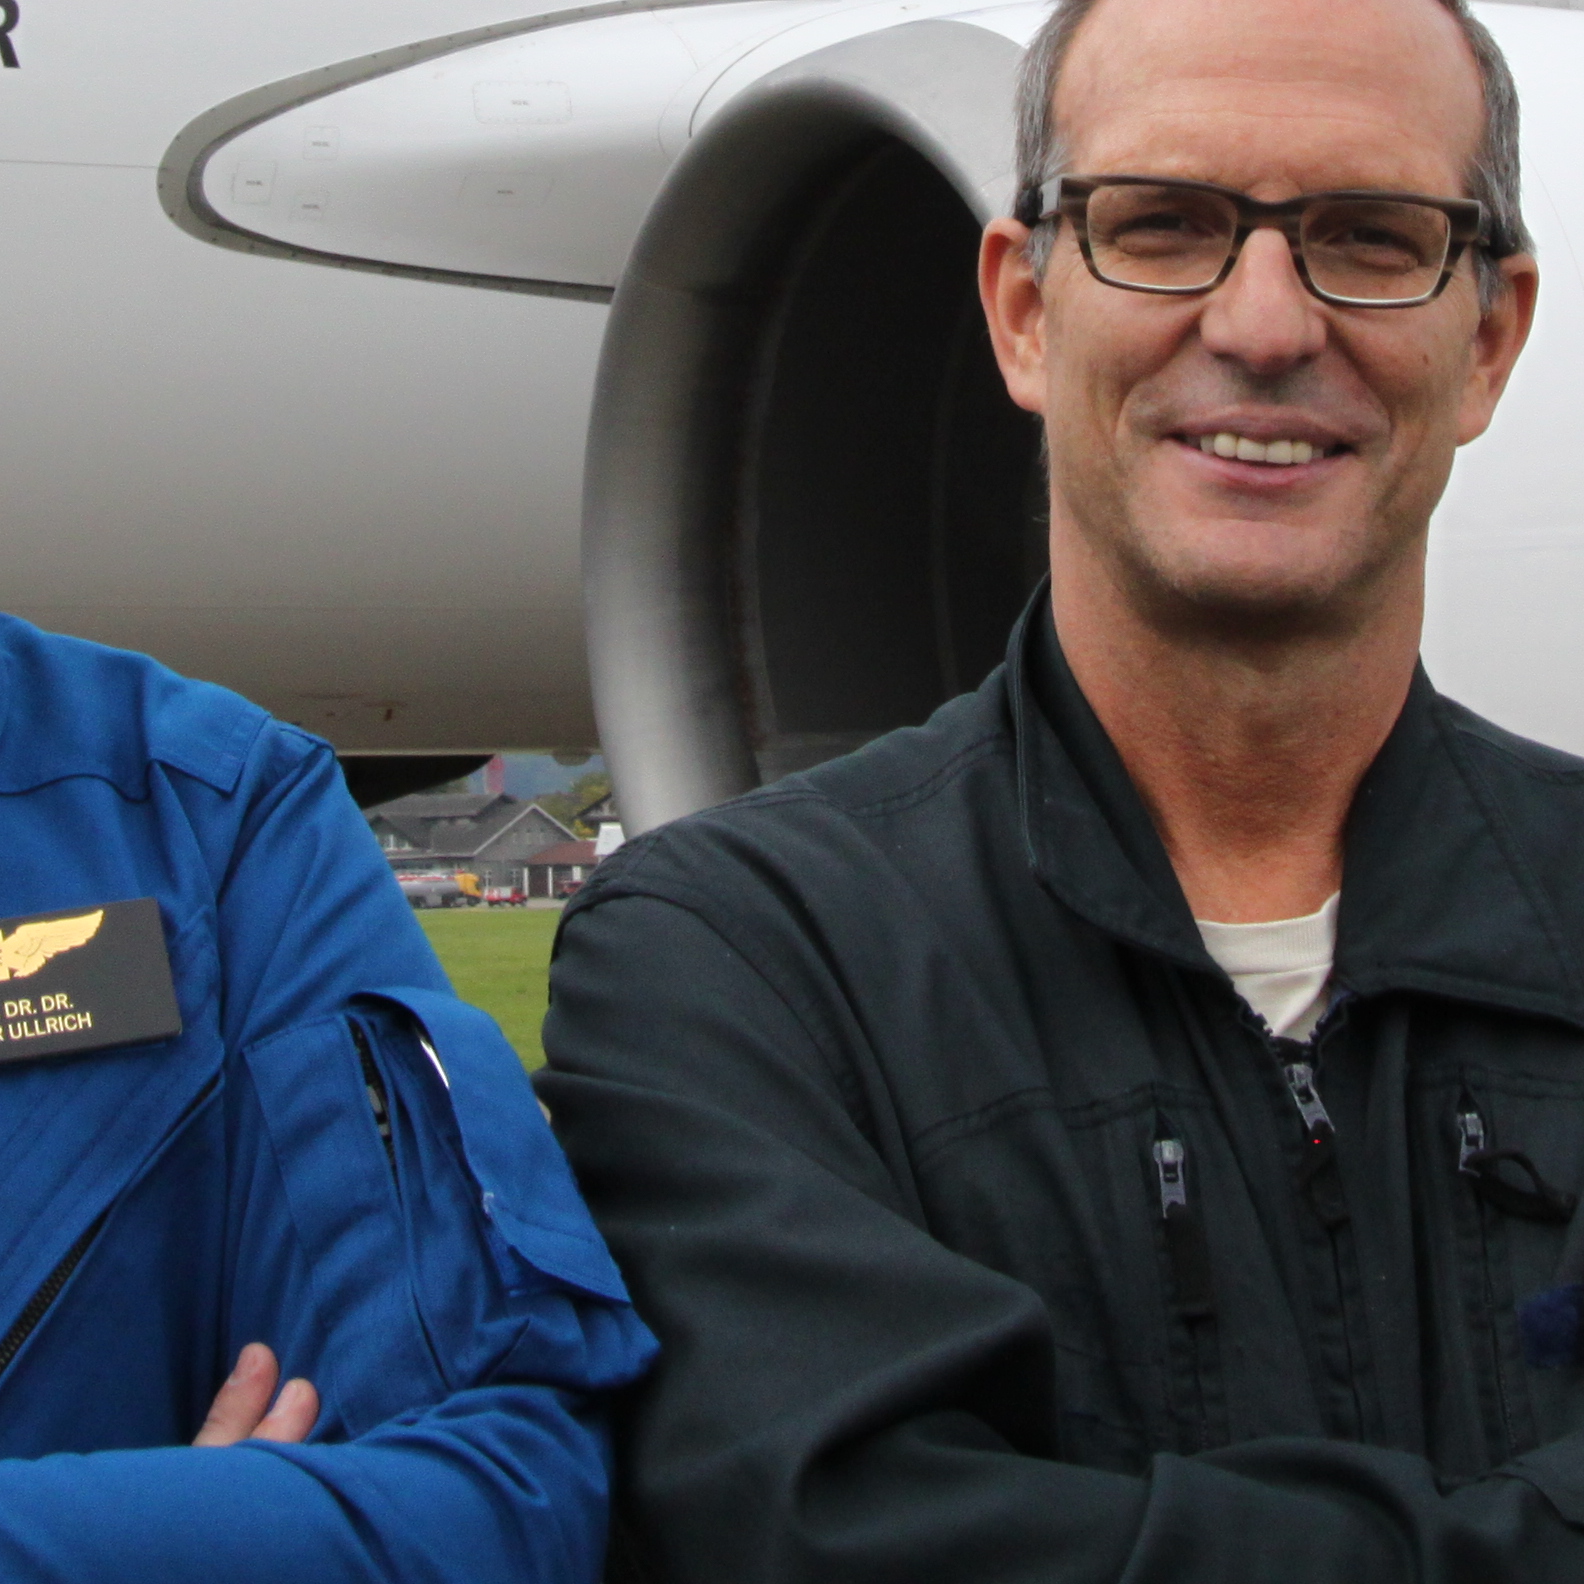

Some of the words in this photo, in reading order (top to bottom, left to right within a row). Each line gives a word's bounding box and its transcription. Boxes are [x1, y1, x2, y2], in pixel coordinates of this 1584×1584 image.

[4, 999, 37, 1017] DR.
[41, 993, 74, 1012] DR.
[8, 1012, 92, 1039] ULLRICH
